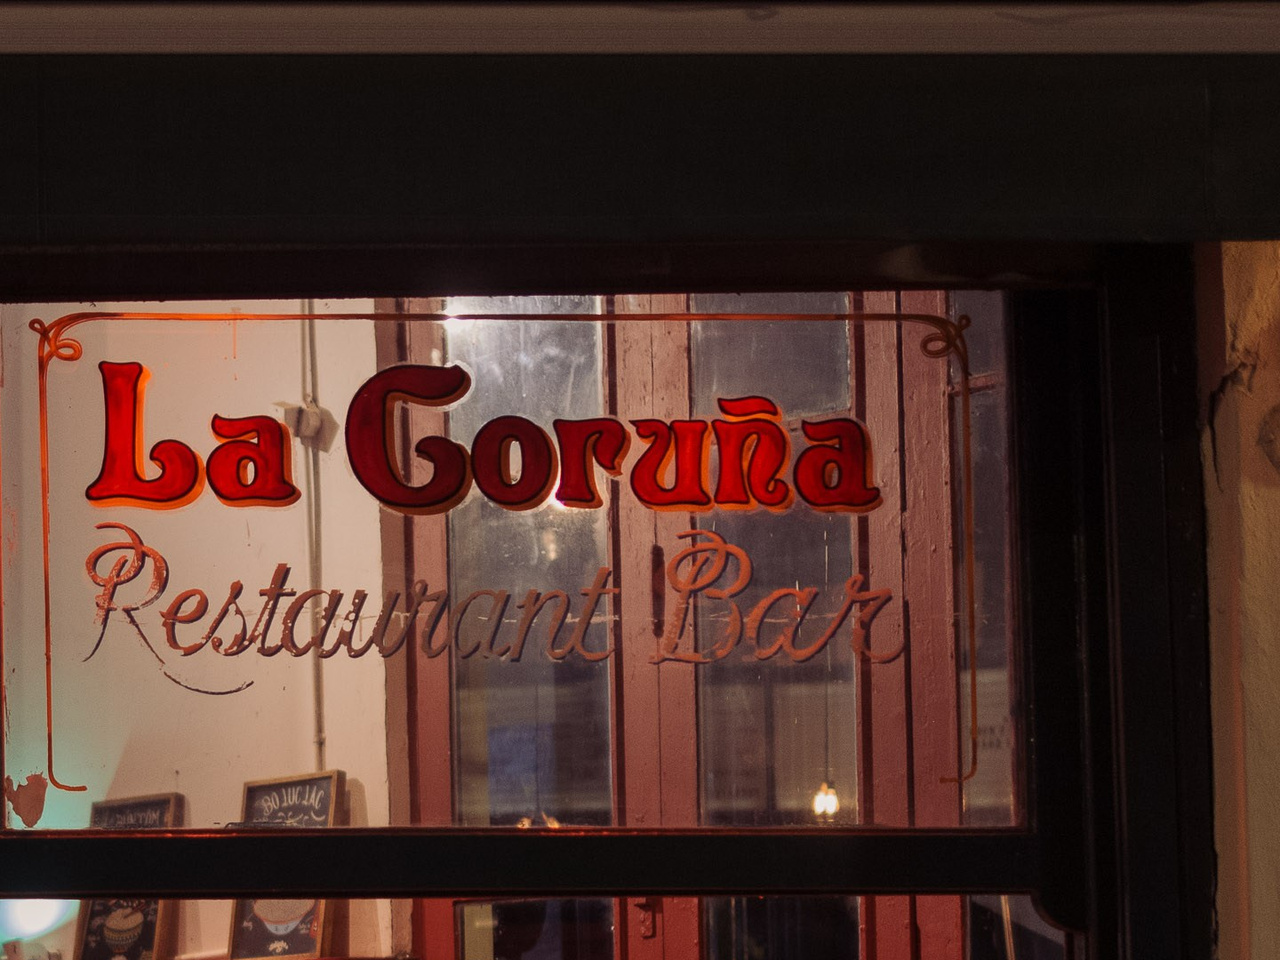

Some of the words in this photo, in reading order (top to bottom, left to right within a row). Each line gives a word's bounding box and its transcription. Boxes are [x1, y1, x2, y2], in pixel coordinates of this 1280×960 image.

[85, 360, 302, 511] La
[345, 362, 883, 516] Coruña
[82, 522, 620, 696] Restaurant
[648, 530, 908, 665] Bar
